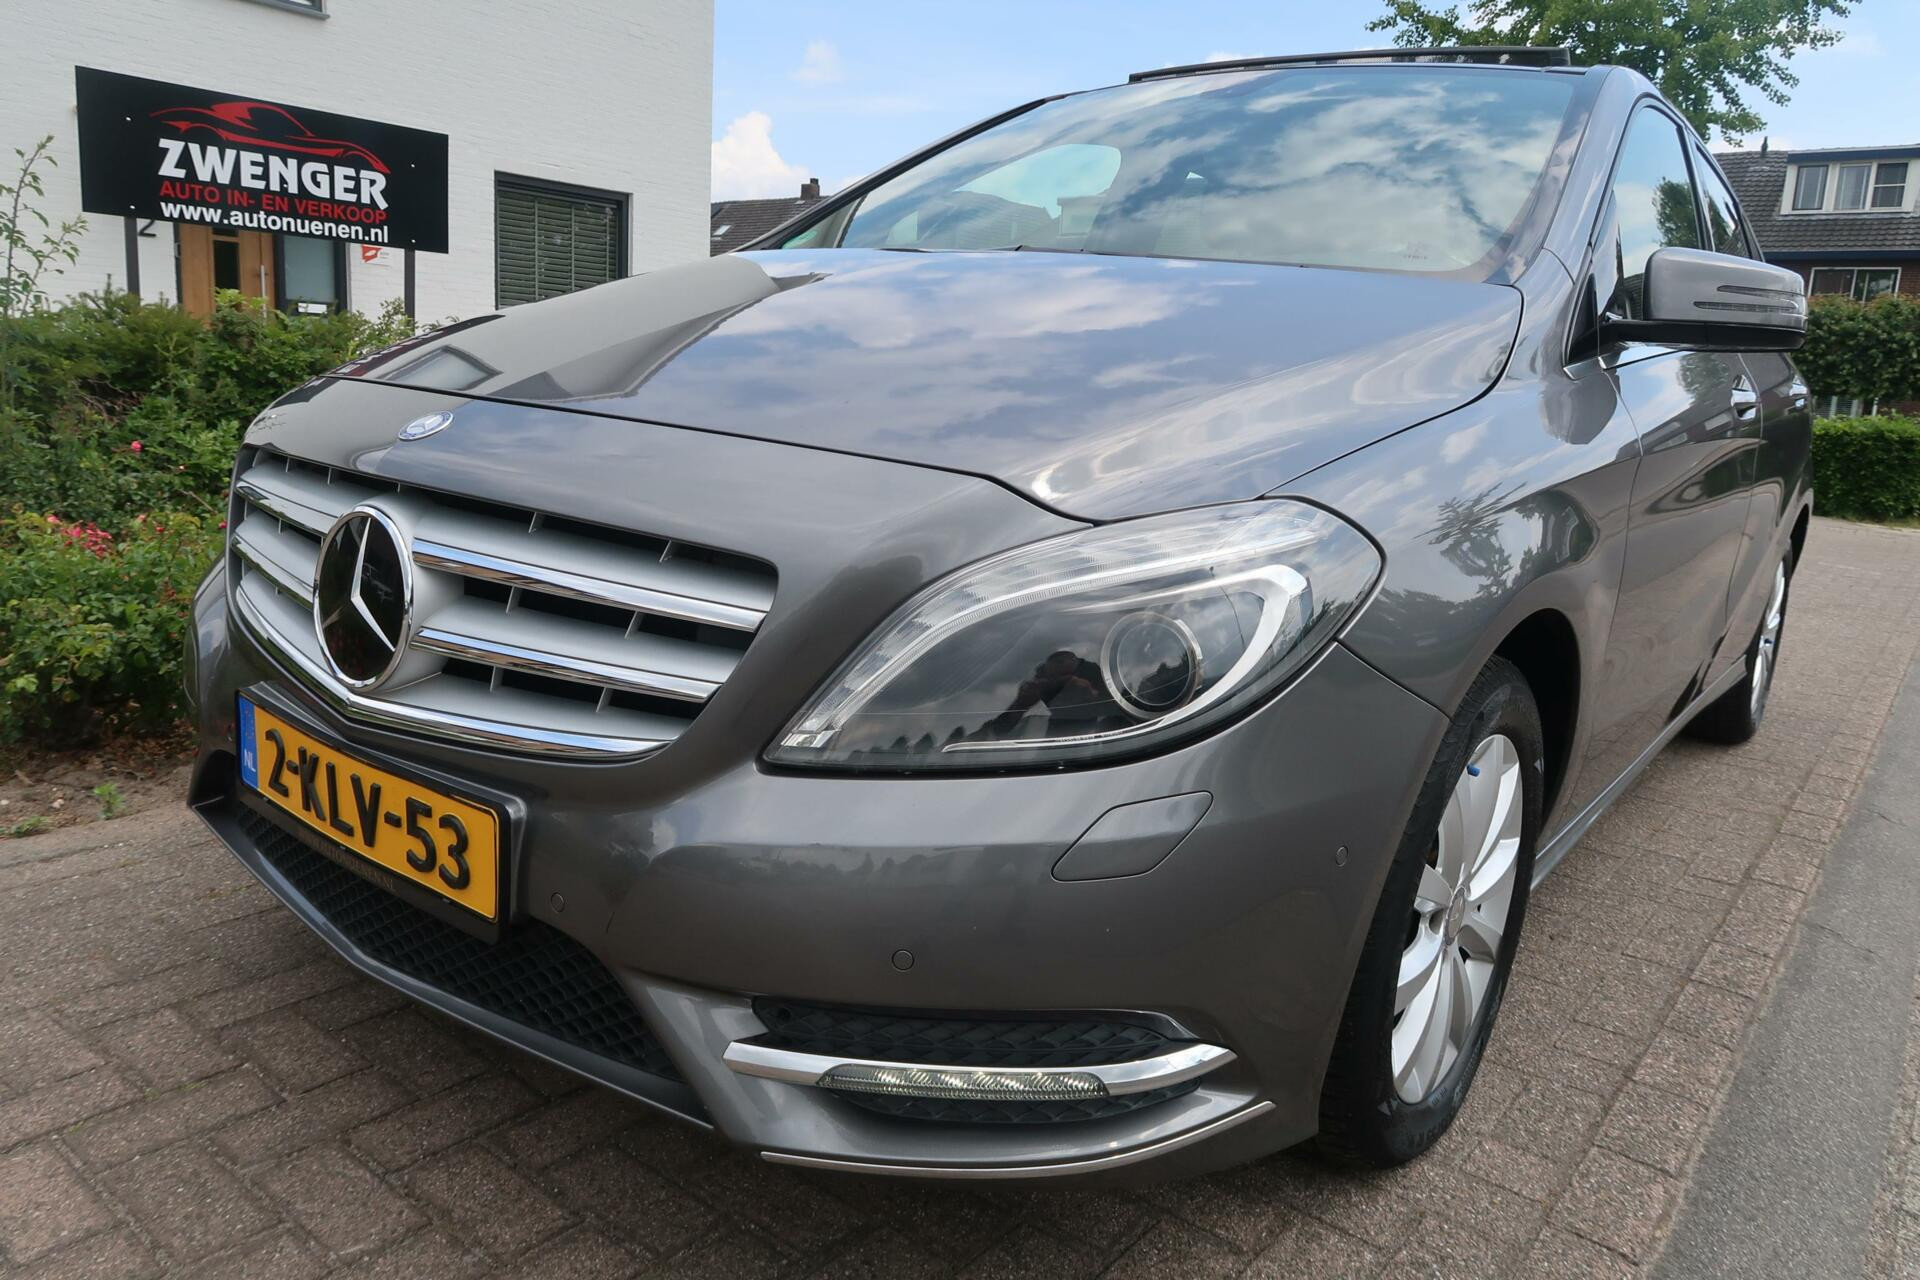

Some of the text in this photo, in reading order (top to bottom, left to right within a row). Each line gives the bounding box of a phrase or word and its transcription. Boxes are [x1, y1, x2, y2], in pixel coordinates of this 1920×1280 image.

[158, 138, 389, 210] ZWENGER
[160, 180, 388, 224] AUTO IN- EN VERKOOP
[160, 202, 389, 243] www.autonuenen.nl
[243, 748, 257, 773] NL
[264, 728, 471, 891] 2-KLV-53
